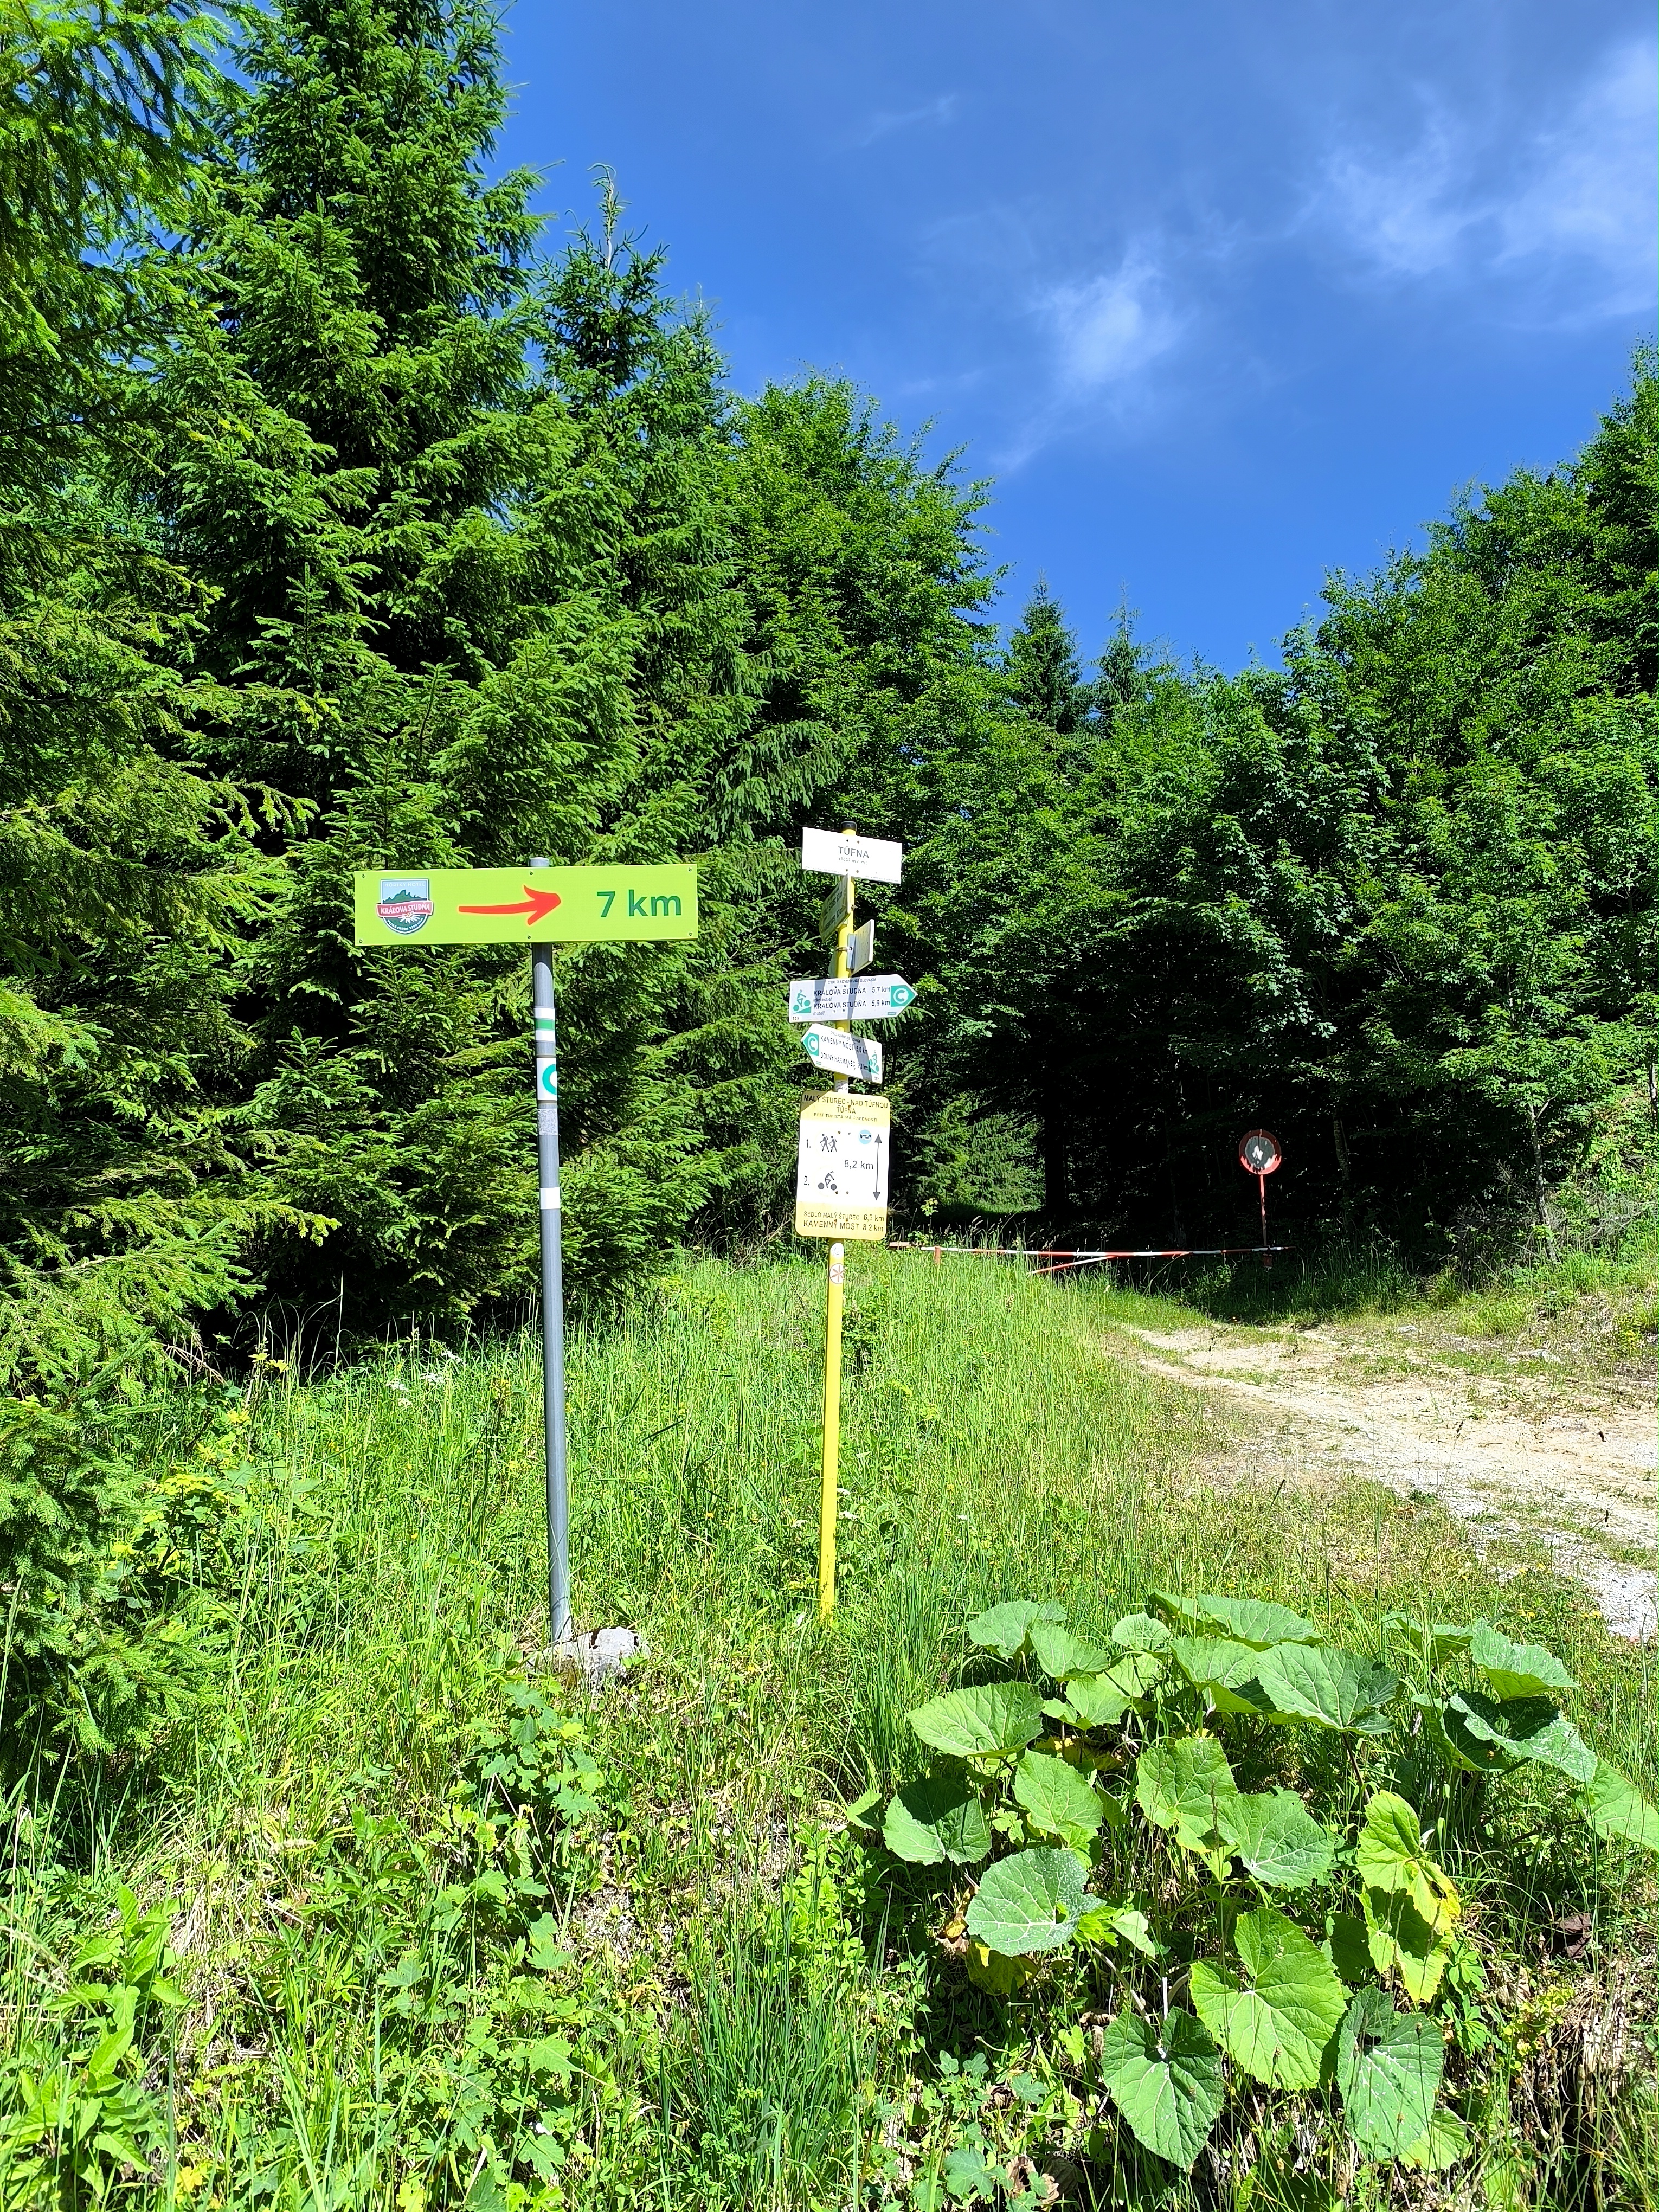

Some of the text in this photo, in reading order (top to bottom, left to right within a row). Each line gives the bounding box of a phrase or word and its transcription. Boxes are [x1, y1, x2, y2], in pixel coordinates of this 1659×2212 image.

[838, 845, 869, 859] TÚFNA
[381, 902, 430, 914] KRÁĽOVA STUDŇA
[596, 889, 682, 917] 7 km
[842, 986, 866, 994] STUDŇA
[813, 1001, 841, 1009] KRÁĽOVA
[843, 1000, 866, 1008] STUDŇA
[820, 1034, 841, 1046] KAMENNÝ
[820, 1052, 833, 1061] DOLNÝ
[834, 1056, 856, 1068] HARMANEC
[822, 1095, 846, 1104] ŠTUREC
[865, 1099, 888, 1109] TÚFNOU
[837, 1105, 856, 1114] TÚFNA
[806, 1139, 811, 1148] 1.
[844, 1160, 874, 1170] 8,2 km
[803, 1176, 809, 1186] 2.
[838, 1212, 860, 1220] ŠTUREC
[863, 1213, 873, 1222] 6,3
[874, 1214, 884, 1222] km
[803, 1219, 884, 1232] KAMENNÝ MOST 8,2 km
